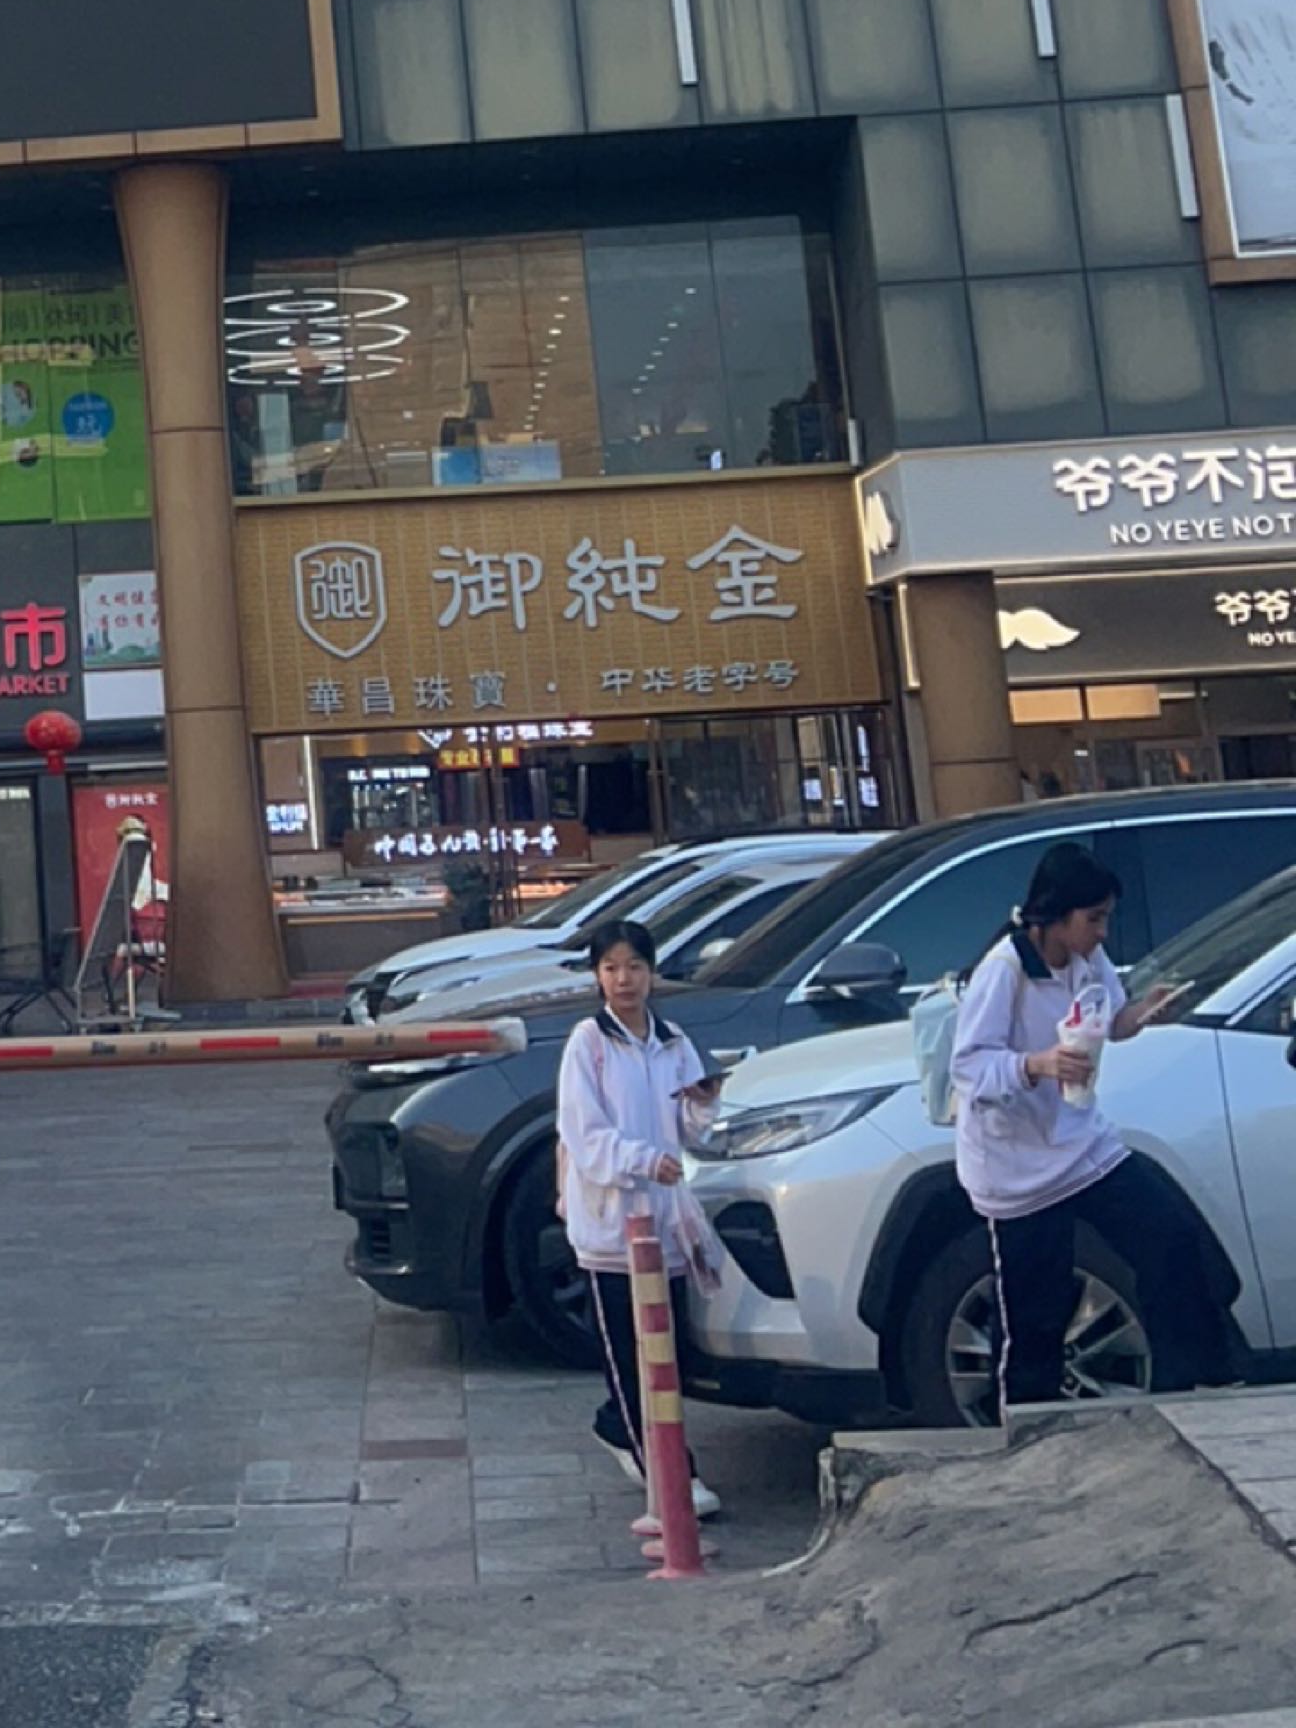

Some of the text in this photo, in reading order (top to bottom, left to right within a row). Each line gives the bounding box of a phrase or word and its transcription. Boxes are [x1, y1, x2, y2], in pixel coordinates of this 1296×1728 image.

[1110, 521, 1152, 544] NO
[1157, 517, 1225, 541] YEYE
[432, 524, 803, 632] 御純金
[1215, 588, 1296, 626] 爷爷
[600, 660, 800, 696] 中华老字号
